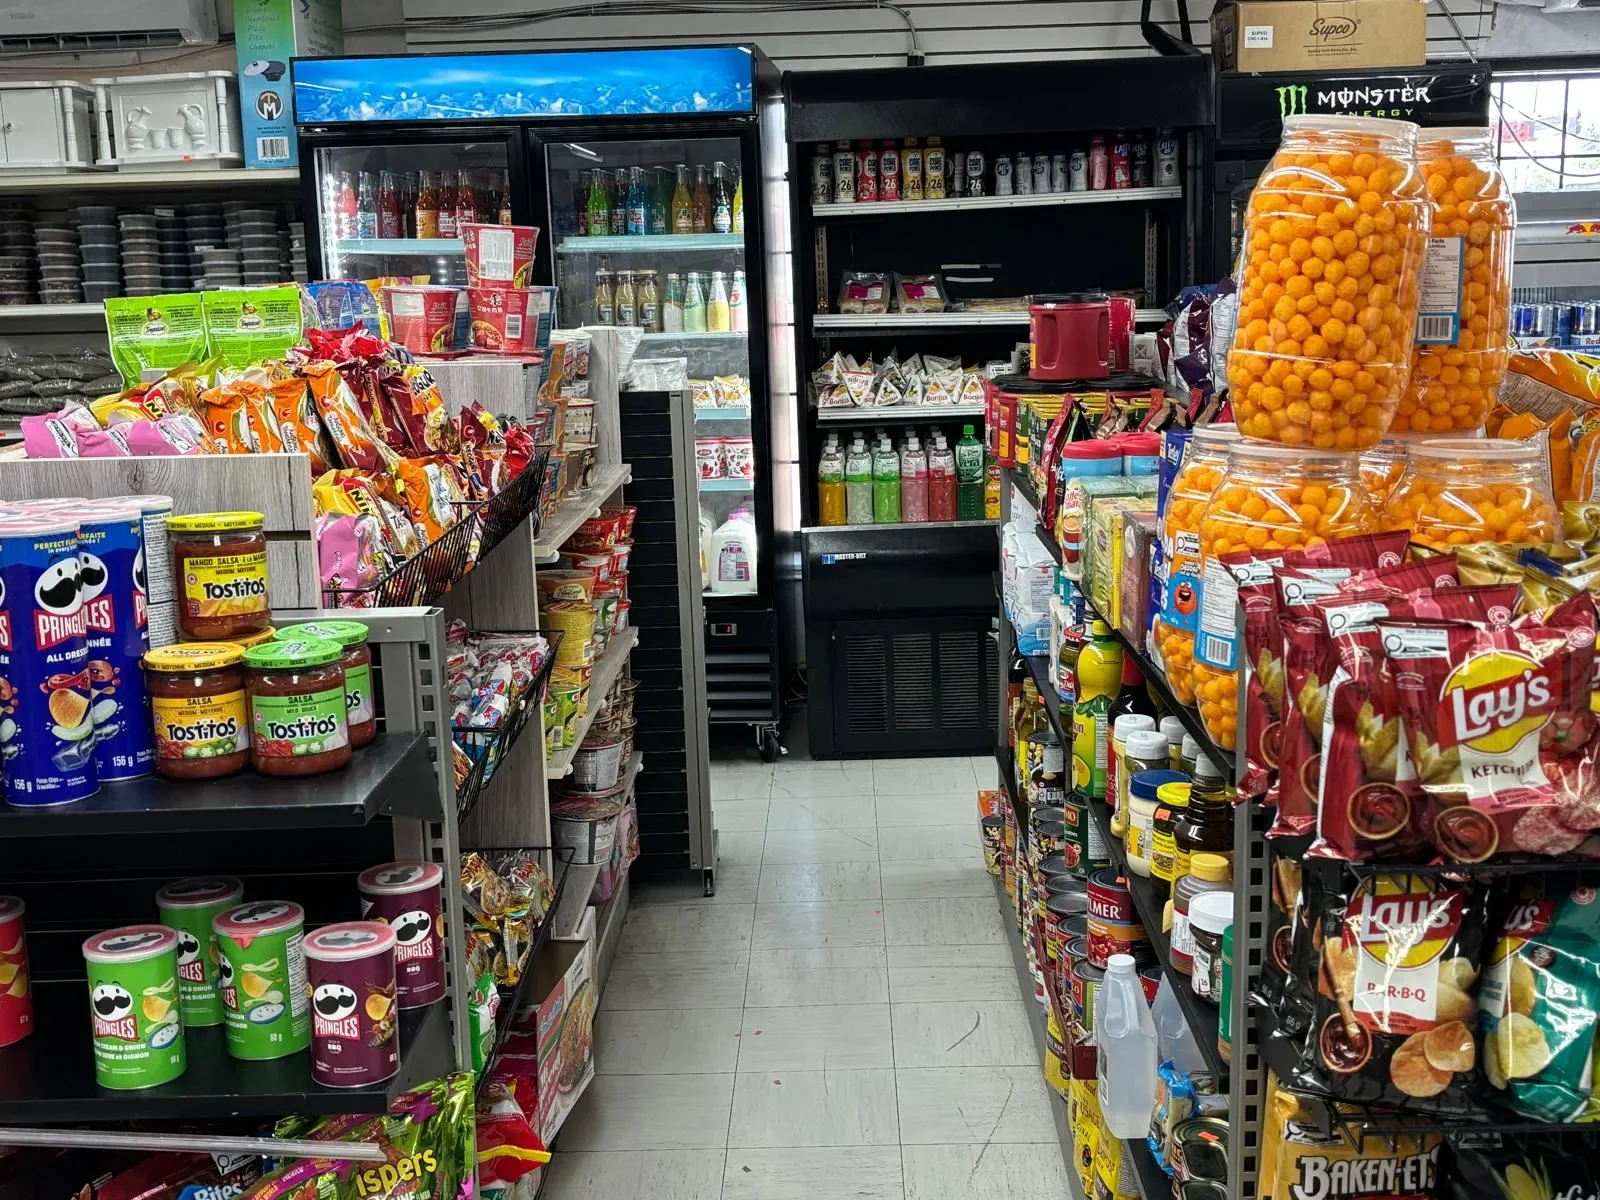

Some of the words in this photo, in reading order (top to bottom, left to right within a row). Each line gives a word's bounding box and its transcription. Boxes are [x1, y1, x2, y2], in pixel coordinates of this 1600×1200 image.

[1309, 18, 1352, 42] Supco
[1316, 86, 1432, 109] MONSTER
[883, 158, 896, 167] CORE
[929, 157, 942, 166] CORE
[840, 179, 852, 191] 26
[885, 179, 897, 190] 26
[910, 179, 921, 190] 26
[931, 178, 942, 189] 26
[969, 179, 982, 190] 26
[33, 541, 65, 551] PERFECT
[189, 559, 214, 567] MANGO
[217, 557, 240, 566] SALSA
[46, 652, 64, 664] ALL
[65, 647, 89, 661] DRESS
[186, 697, 213, 706] SALSA
[287, 695, 314, 704] SALSA
[301, 705, 317, 713] DOUCE
[1451, 669, 1551, 742] Lay's
[177, 709, 197, 717] MEDIUM
[199, 707, 224, 715] MOYENNE
[112, 756, 126, 767] 156
[127, 757, 134, 769] g
[14, 779, 26, 790] 156
[26, 782, 32, 793] g
[1087, 897, 1122, 920] LMER
[1359, 893, 1452, 946] Lay's
[406, 965, 421, 973] BBQ
[194, 985, 213, 993] ONION
[94, 1017, 137, 1041] PRINGLES
[314, 1014, 360, 1040] PRINGLES
[124, 1043, 147, 1051] ONION
[327, 1044, 342, 1052] BBQ
[123, 1052, 150, 1060] OIGNON
[193, 1181, 244, 1200] Bites
